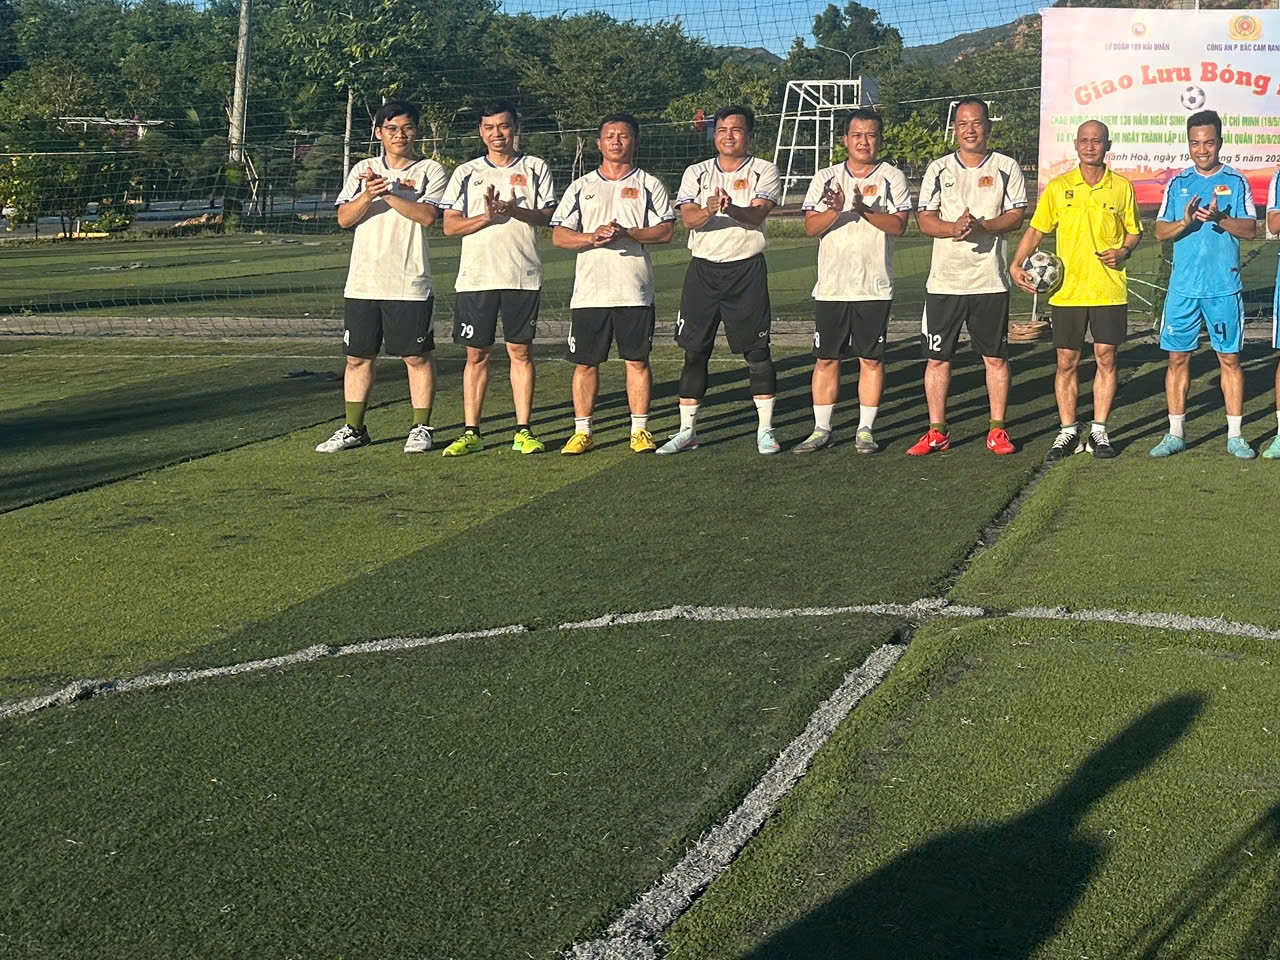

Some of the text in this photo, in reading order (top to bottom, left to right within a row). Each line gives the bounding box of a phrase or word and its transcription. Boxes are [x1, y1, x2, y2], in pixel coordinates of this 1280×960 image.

[1207, 42, 1223, 52] CÔNG
[1224, 43, 1233, 52] AN
[1253, 43, 1267, 52] CAM
[1074, 74, 1134, 106] Giao
[1140, 64, 1192, 85] Lưu
[1200, 61, 1272, 96] Bóng
[1150, 113, 1168, 126] NGÀY
[1169, 115, 1186, 126] SINH
[1242, 116, 1260, 127] MINH
[1153, 152, 1177, 163] ngày
[1234, 153, 1241, 162] 5
[1214, 321, 1227, 341] 4
[927, 333, 942, 352] 12
